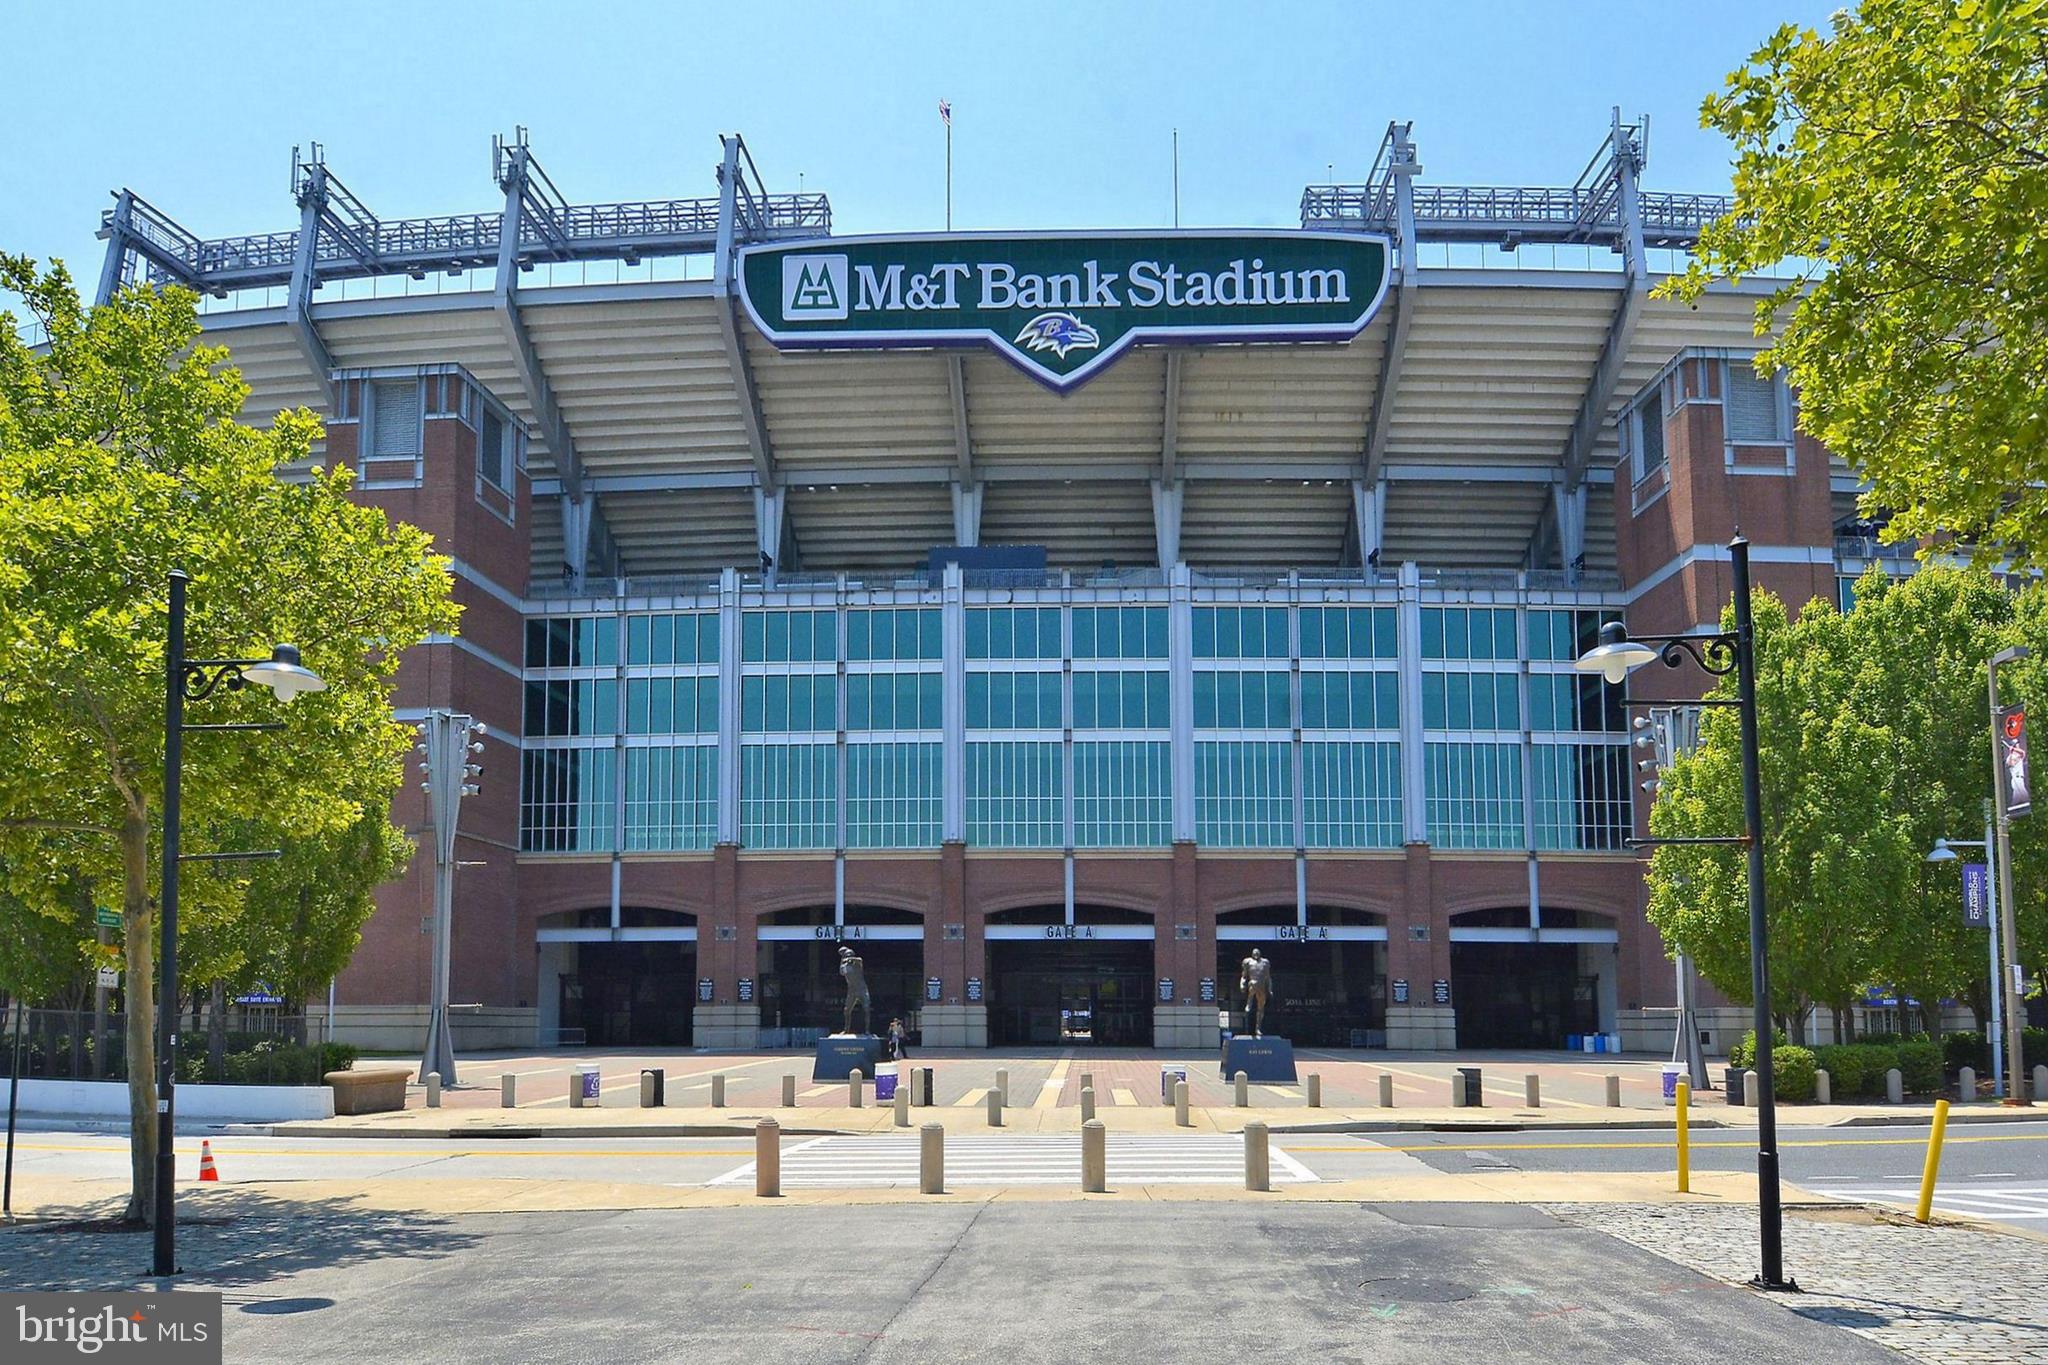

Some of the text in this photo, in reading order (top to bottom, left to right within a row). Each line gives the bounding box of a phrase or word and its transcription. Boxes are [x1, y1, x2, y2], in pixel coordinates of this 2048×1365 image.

[854, 258, 1351, 311] M&T Bank Stadium
[1972, 871, 1980, 920] CHAMPIONS
[854, 926, 861, 938] A
[1047, 925, 1092, 938] GATE A
[1280, 926, 1326, 939] GATE A
